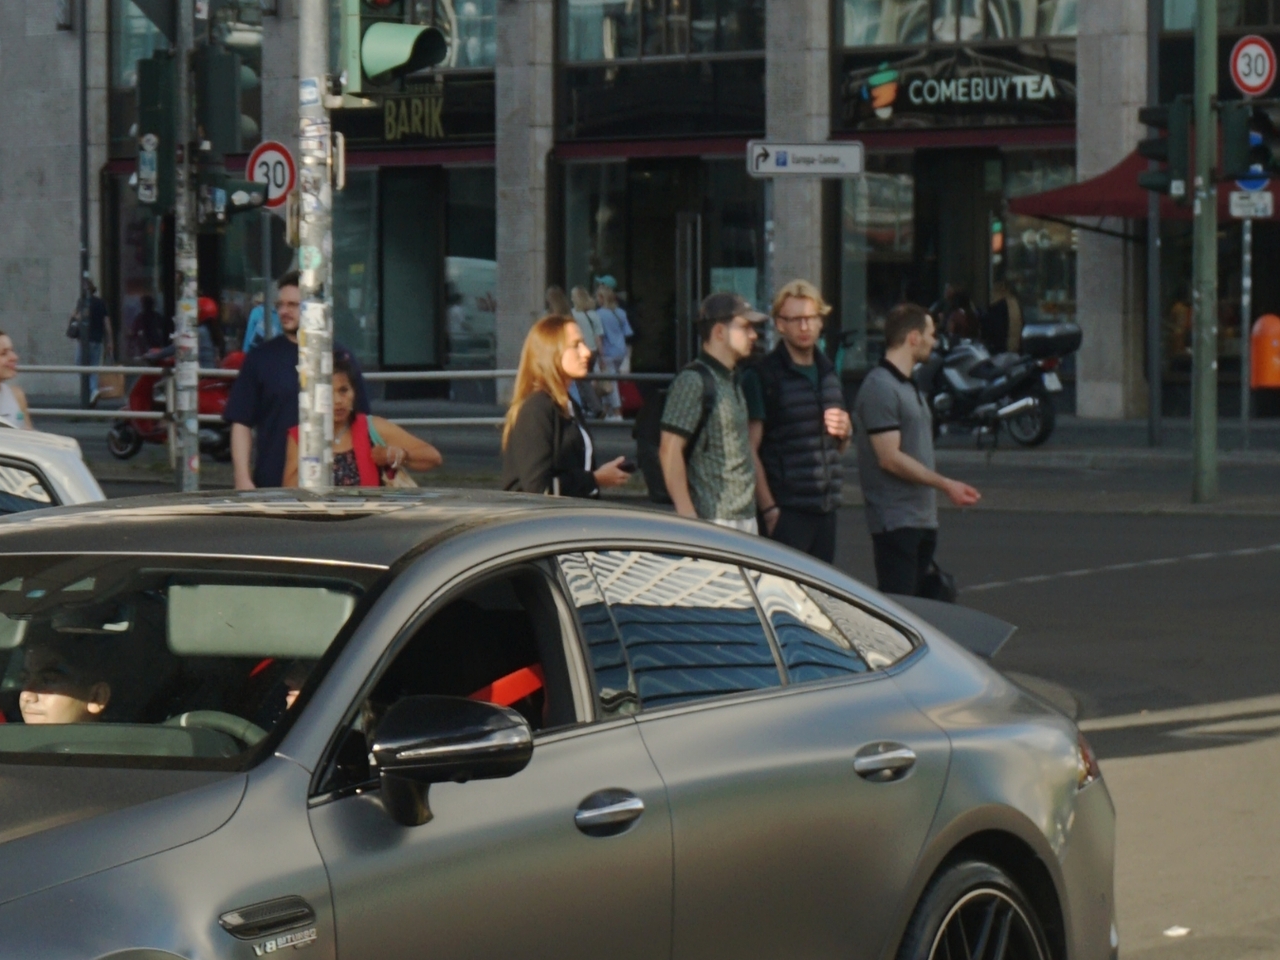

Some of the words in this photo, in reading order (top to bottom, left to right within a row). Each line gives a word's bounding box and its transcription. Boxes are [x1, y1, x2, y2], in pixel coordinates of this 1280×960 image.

[1241, 53, 1266, 77] 30
[384, 98, 444, 140] BARIK
[258, 160, 285, 189] 30
